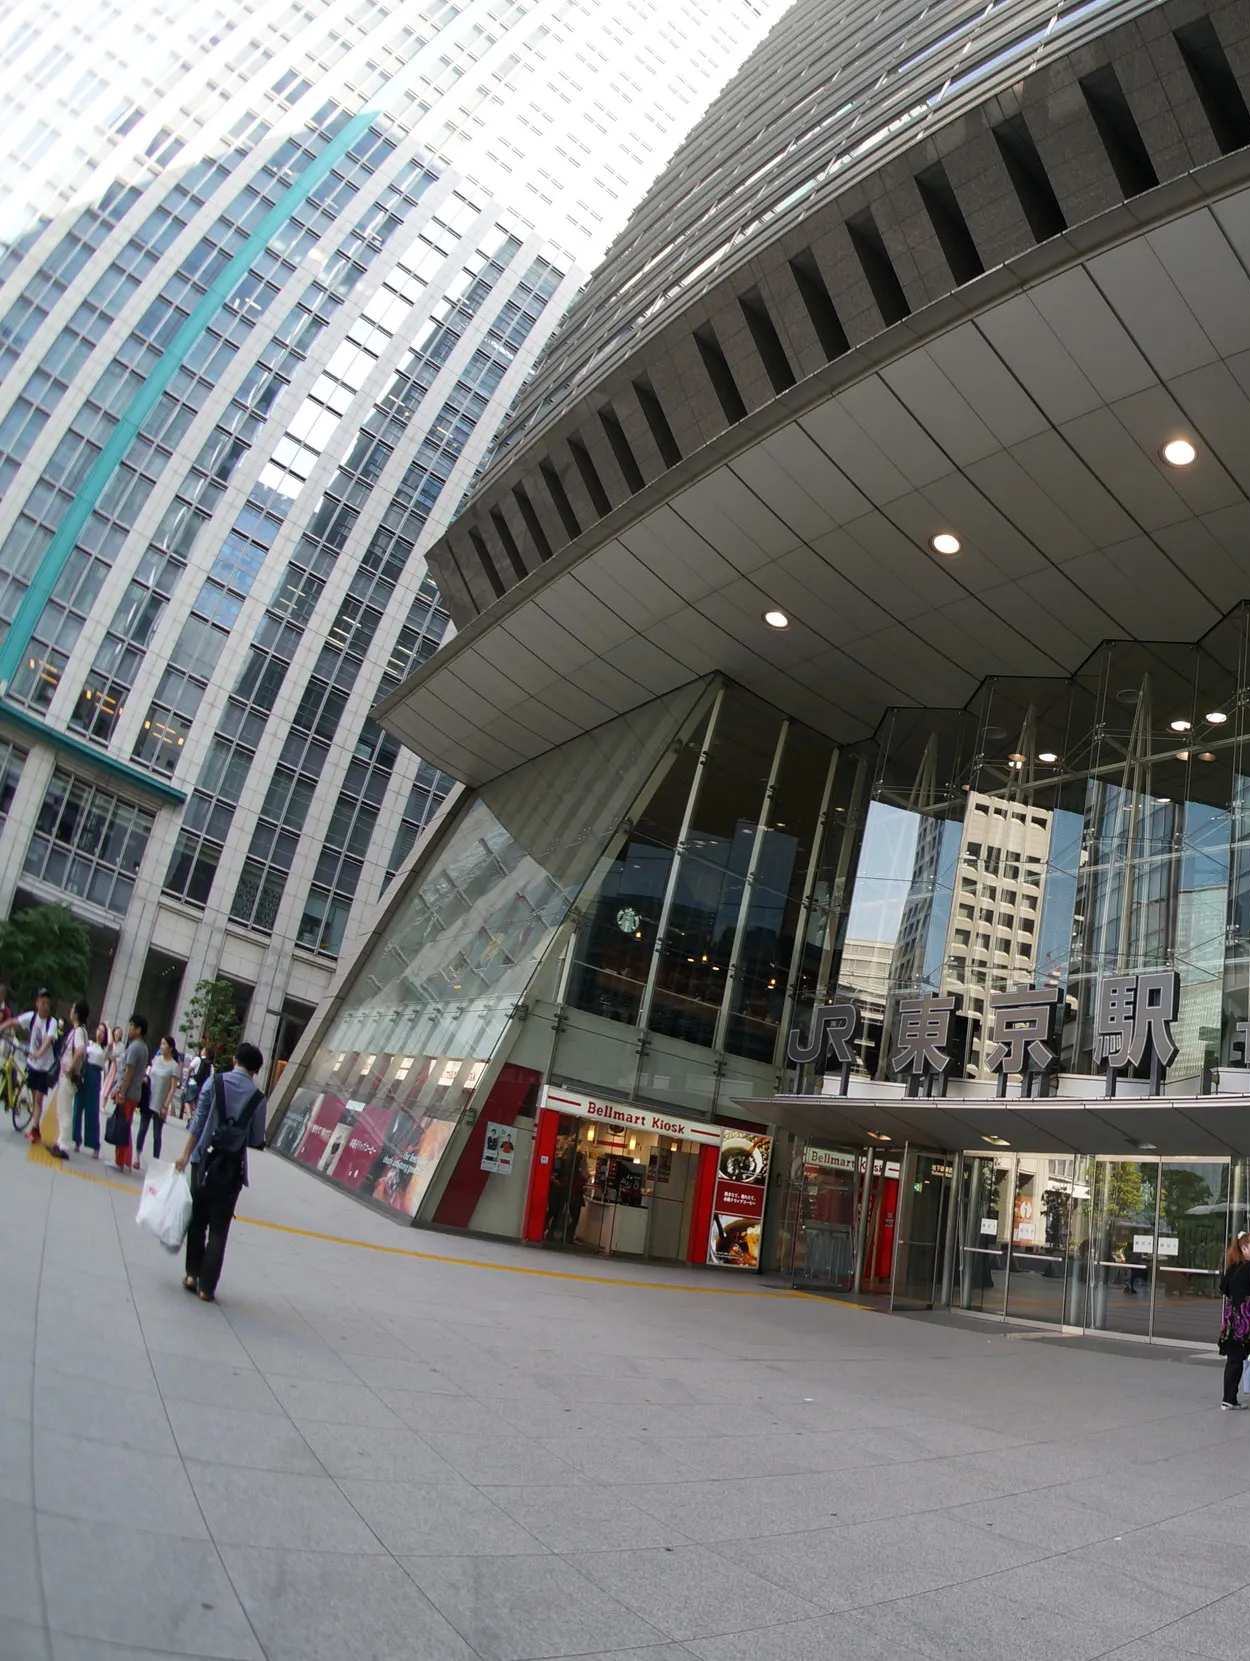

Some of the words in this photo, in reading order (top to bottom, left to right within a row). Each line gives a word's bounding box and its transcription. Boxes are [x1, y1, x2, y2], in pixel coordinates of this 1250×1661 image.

[587, 1102, 647, 1126] Bellmart
[651, 1117, 686, 1134] Kiosk
[811, 1151, 856, 1169] Bellmart
